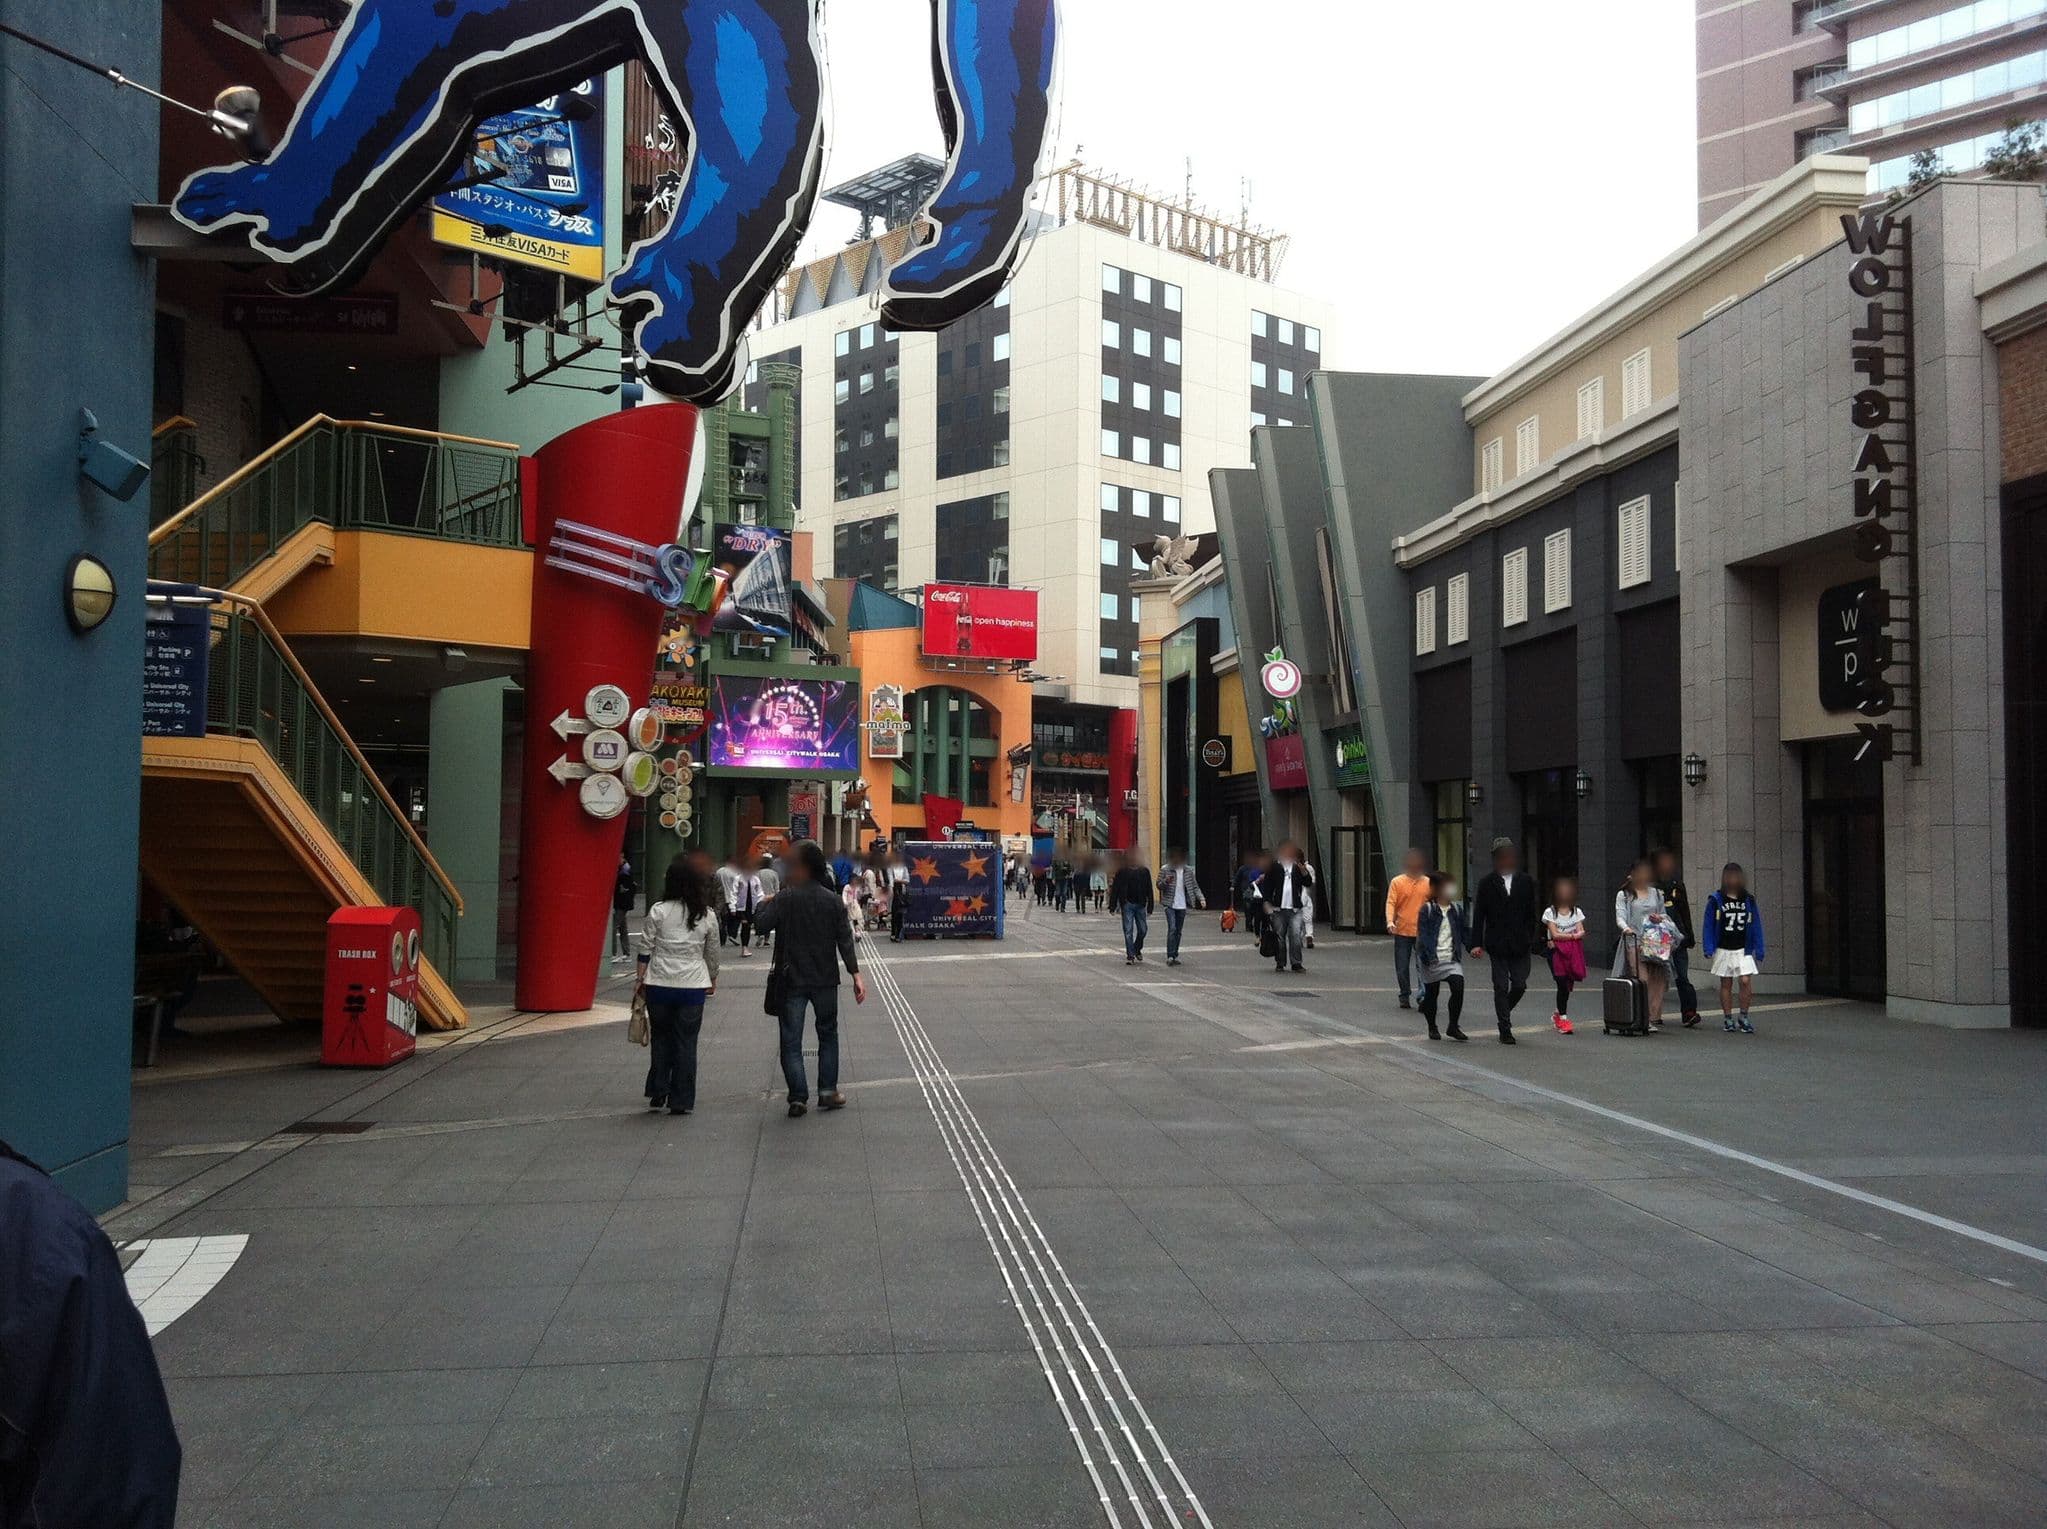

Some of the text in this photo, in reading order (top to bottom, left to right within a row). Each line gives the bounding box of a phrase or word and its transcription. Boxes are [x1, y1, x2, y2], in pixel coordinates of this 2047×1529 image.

[551, 177, 573, 188] VISA
[974, 616, 1034, 628] open happiness
[650, 685, 710, 698] AKOYAKI
[672, 698, 705, 706] MUSEUM
[1725, 912, 1746, 931] 75
[338, 949, 361, 959] TRASH
